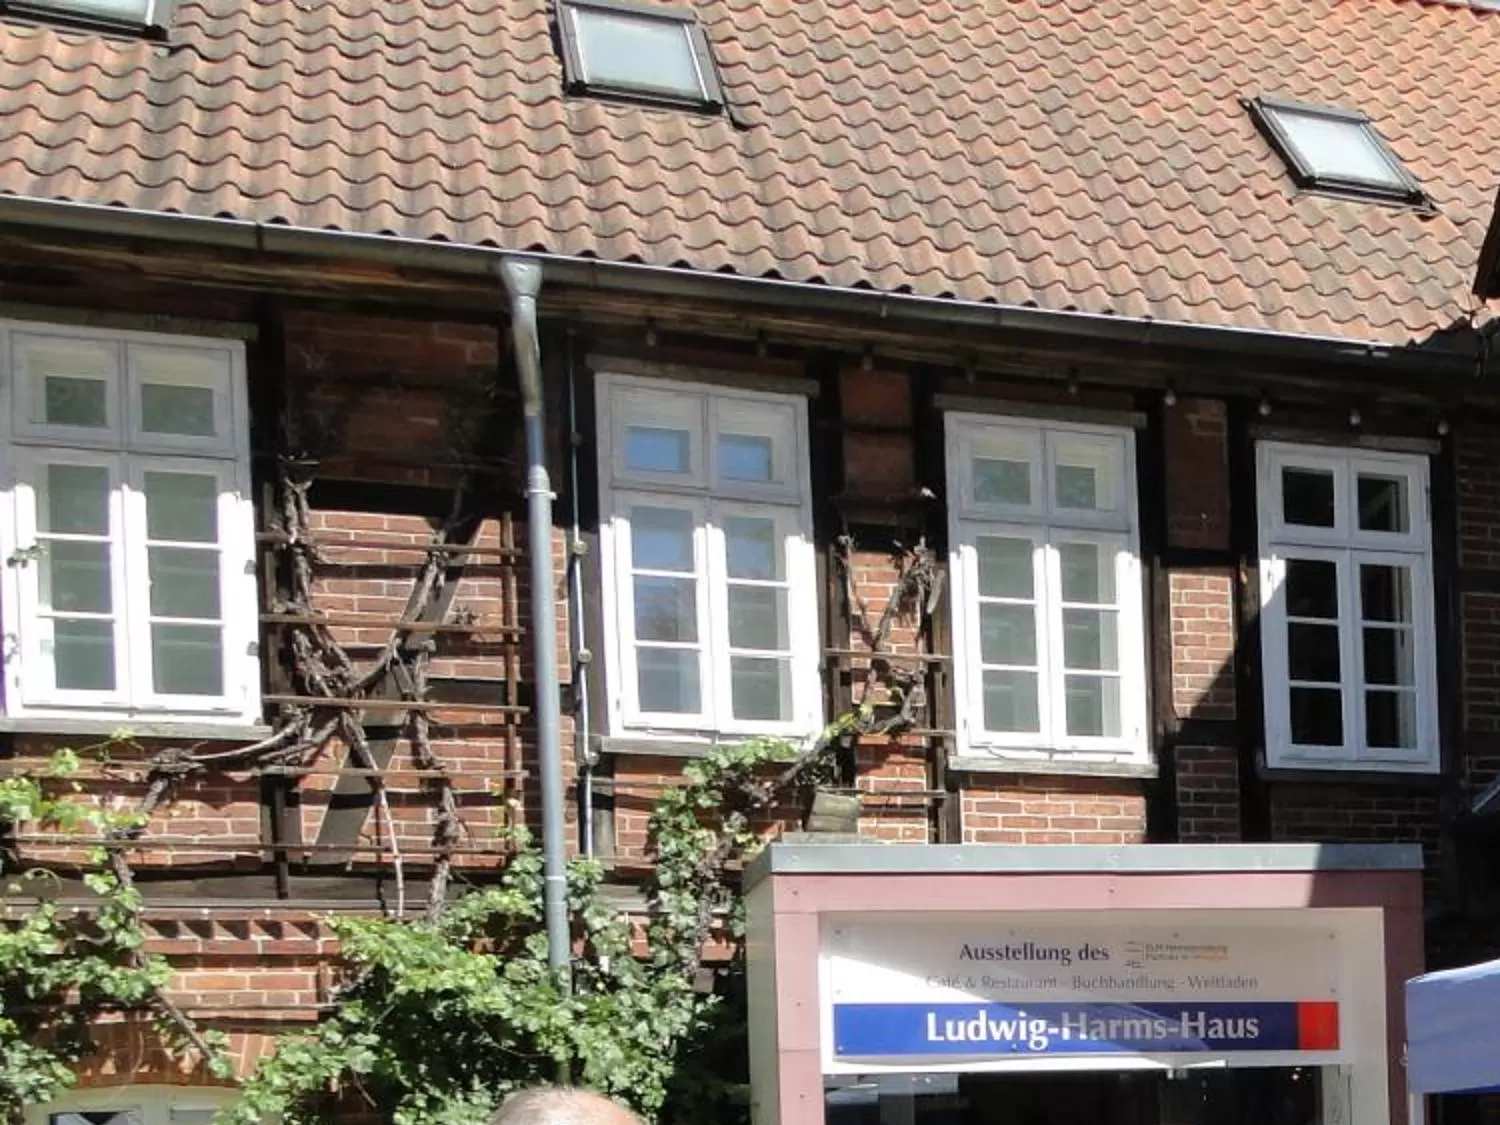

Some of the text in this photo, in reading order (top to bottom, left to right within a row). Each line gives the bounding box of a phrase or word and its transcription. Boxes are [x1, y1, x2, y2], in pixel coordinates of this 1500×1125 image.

[960, 941, 1110, 966] Ausstellung des
[981, 975, 1058, 989] Restaurant
[1072, 975, 1176, 991] Buchhandlung
[1188, 975, 1259, 989] Weltladen
[926, 1008, 1260, 1051] Ludwig-Harms-Haus
